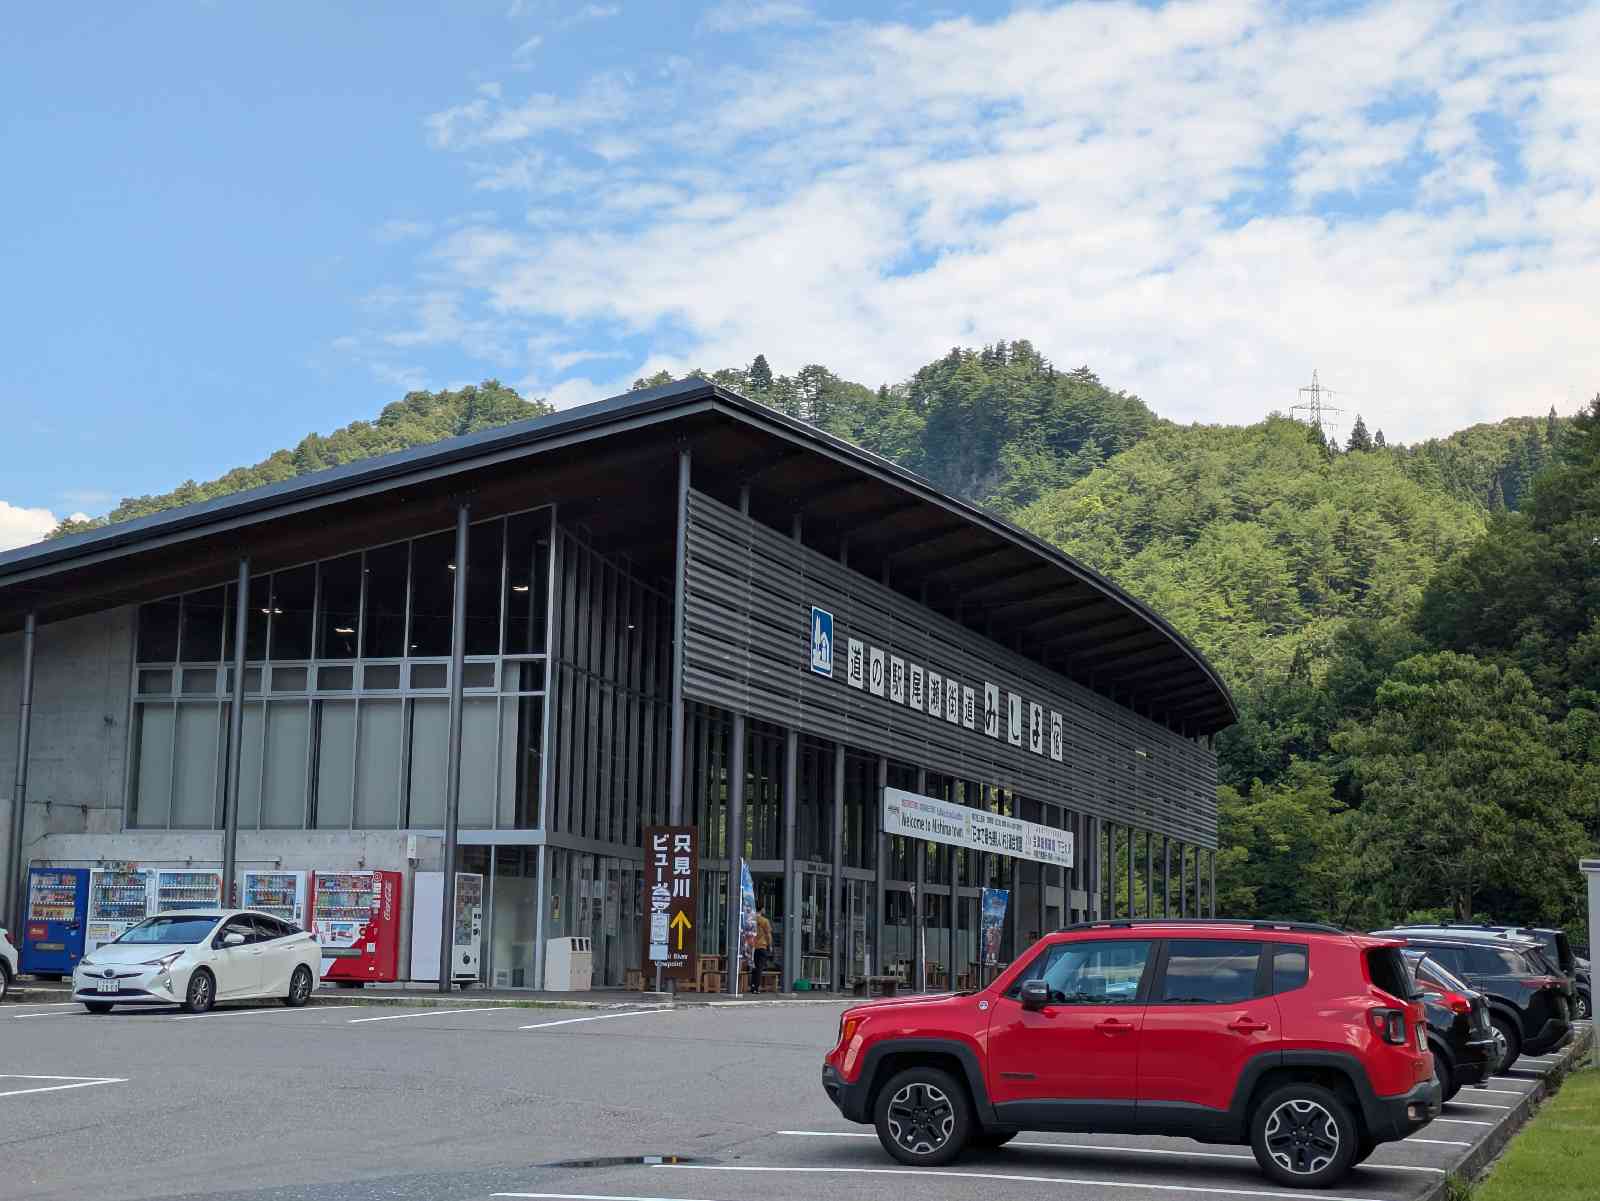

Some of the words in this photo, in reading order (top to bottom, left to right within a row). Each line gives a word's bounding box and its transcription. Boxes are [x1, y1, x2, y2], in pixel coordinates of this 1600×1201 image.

[672, 834, 692, 898] 只見川
[654, 960, 683, 969] Vwpoint
